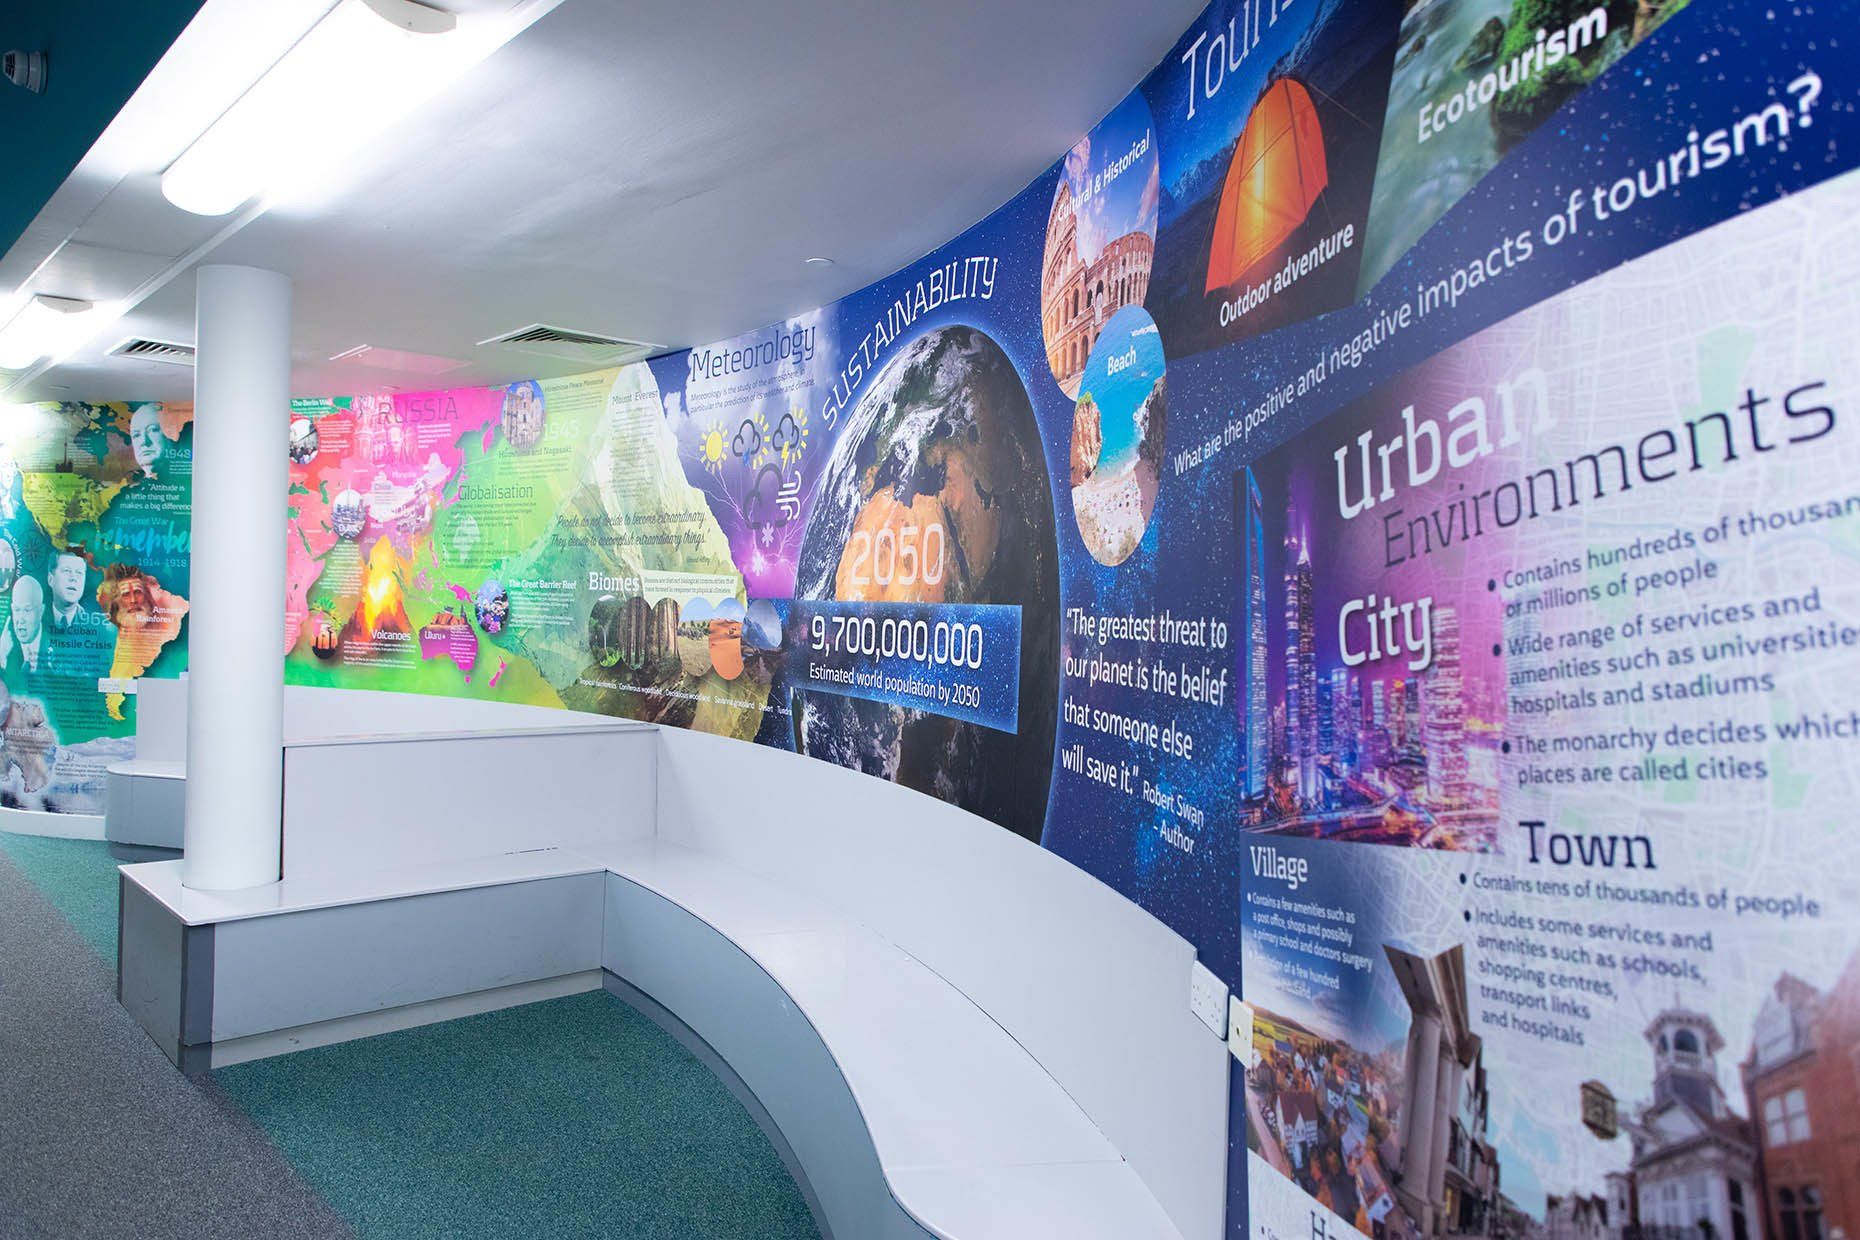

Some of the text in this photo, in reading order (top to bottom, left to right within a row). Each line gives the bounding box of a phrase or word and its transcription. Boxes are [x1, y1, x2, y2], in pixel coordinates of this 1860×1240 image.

[1418, 7, 1608, 144] Ecotourism
[1057, 128, 1150, 222] Cultural & Historical
[1174, 73, 1823, 476] What are the positive and negative impacts of tourism?
[1219, 223, 1354, 327] Outdoor adventure
[692, 326, 816, 382] Meteorology
[822, 256, 998, 431] SUSTAINABILITY
[1107, 345, 1136, 376] Beach
[377, 396, 459, 426] RUSSIA
[635, 389, 658, 401] Everest
[1334, 367, 1558, 521] Urban
[458, 483, 533, 501] Globalisation
[1384, 380, 1837, 569] Environments
[150, 501, 161, 511] big
[850, 523, 945, 586] 2050
[1502, 556, 1582, 590] Contains
[1587, 528, 1696, 570] hundreds
[1703, 521, 1730, 544] of
[509, 579, 520, 588] The
[521, 579, 539, 588] Great
[539, 580, 562, 589] Barrier
[588, 571, 640, 592] Biomes
[1506, 558, 1719, 618] or millions of people
[48, 625, 98, 636] The Cuban
[73, 611, 111, 626] 1962
[371, 629, 411, 641] Volcanoes
[1066, 607, 1227, 649] "The greatest threat to
[1338, 593, 1434, 672] City
[1508, 586, 1821, 657] Wide range of services and
[49, 638, 82, 649] Missile
[84, 640, 112, 650] Crisis
[811, 615, 983, 670] 9,700,000,000
[1510, 620, 1860, 687] amenities such as universitie
[809, 663, 980, 708] Estimated world population by 2050
[1065, 652, 1228, 707] our planet is the belief
[1511, 673, 1775, 715] hospitals and stadiums
[1064, 695, 1193, 761] that someone else
[1515, 734, 1547, 756] The
[1552, 727, 1657, 762] monarchy
[1664, 718, 1767, 747] decides
[1062, 745, 1139, 795] will save it."
[1518, 755, 1769, 787] places are called cities
[1143, 779, 1204, 828] Robert Swan
[1160, 819, 1195, 854] Author
[1518, 820, 1658, 870] Town
[1250, 845, 1309, 890] Village
[1252, 892, 1275, 908] Contains
[1281, 896, 1293, 911] few
[1293, 902, 1326, 918] amenities
[1326, 906, 1345, 922] such
[1345, 911, 1356, 925] as
[1472, 871, 1821, 919] Contains tens of thousands of people
[1257, 912, 1270, 924] post
[1287, 917, 1306, 935] shops
[1307, 922, 1320, 937] and
[1321, 927, 1353, 948] possibly
[1258, 929, 1279, 948] primary
[1279, 933, 1299, 950] school
[1299, 940, 1313, 954] and
[1313, 942, 1341, 962] doctors
[1341, 951, 1374, 974] surgery
[1475, 907, 1714, 952] Includes some services and
[1309, 967, 1340, 990] hundred
[1477, 933, 1708, 987] amenities such as schools,
[1478, 958, 1619, 1002] shopping centres,
[1480, 983, 1592, 1021] transport links
[1481, 1008, 1585, 1046] and hospitals
